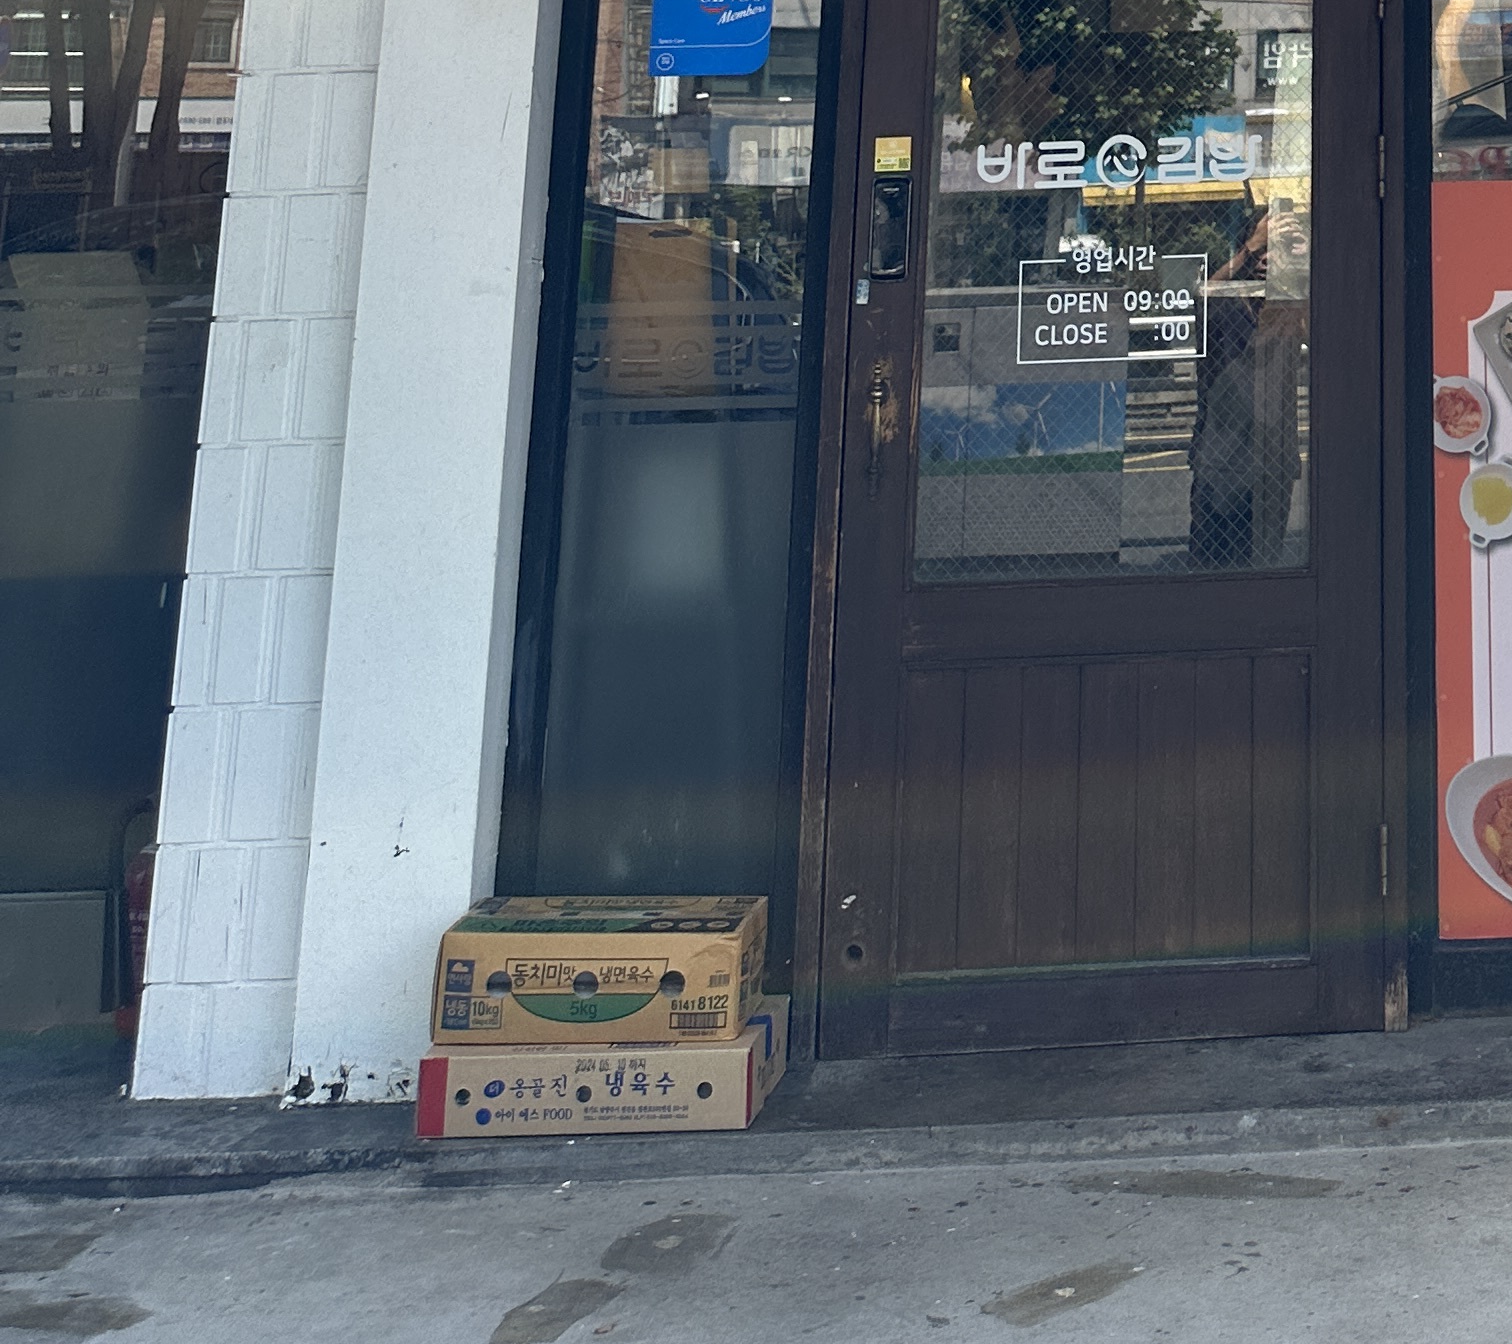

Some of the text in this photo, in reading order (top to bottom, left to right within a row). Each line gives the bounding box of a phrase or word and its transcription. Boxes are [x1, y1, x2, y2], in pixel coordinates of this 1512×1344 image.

[717, 4, 767, 26] Members
[976, 139, 1088, 189] 바로
[1156, 134, 1263, 183] 김밥
[1072, 245, 1156, 273] 영업시간
[1046, 289, 1192, 315] OPEN 09:00
[1035, 324, 1108, 346] CLOSE
[600, 966, 654, 983] 냉면육수
[446, 998, 499, 1018] 냉동 10kg
[569, 1000, 598, 1019] 5kg
[543, 1109, 573, 1121] FOOD
